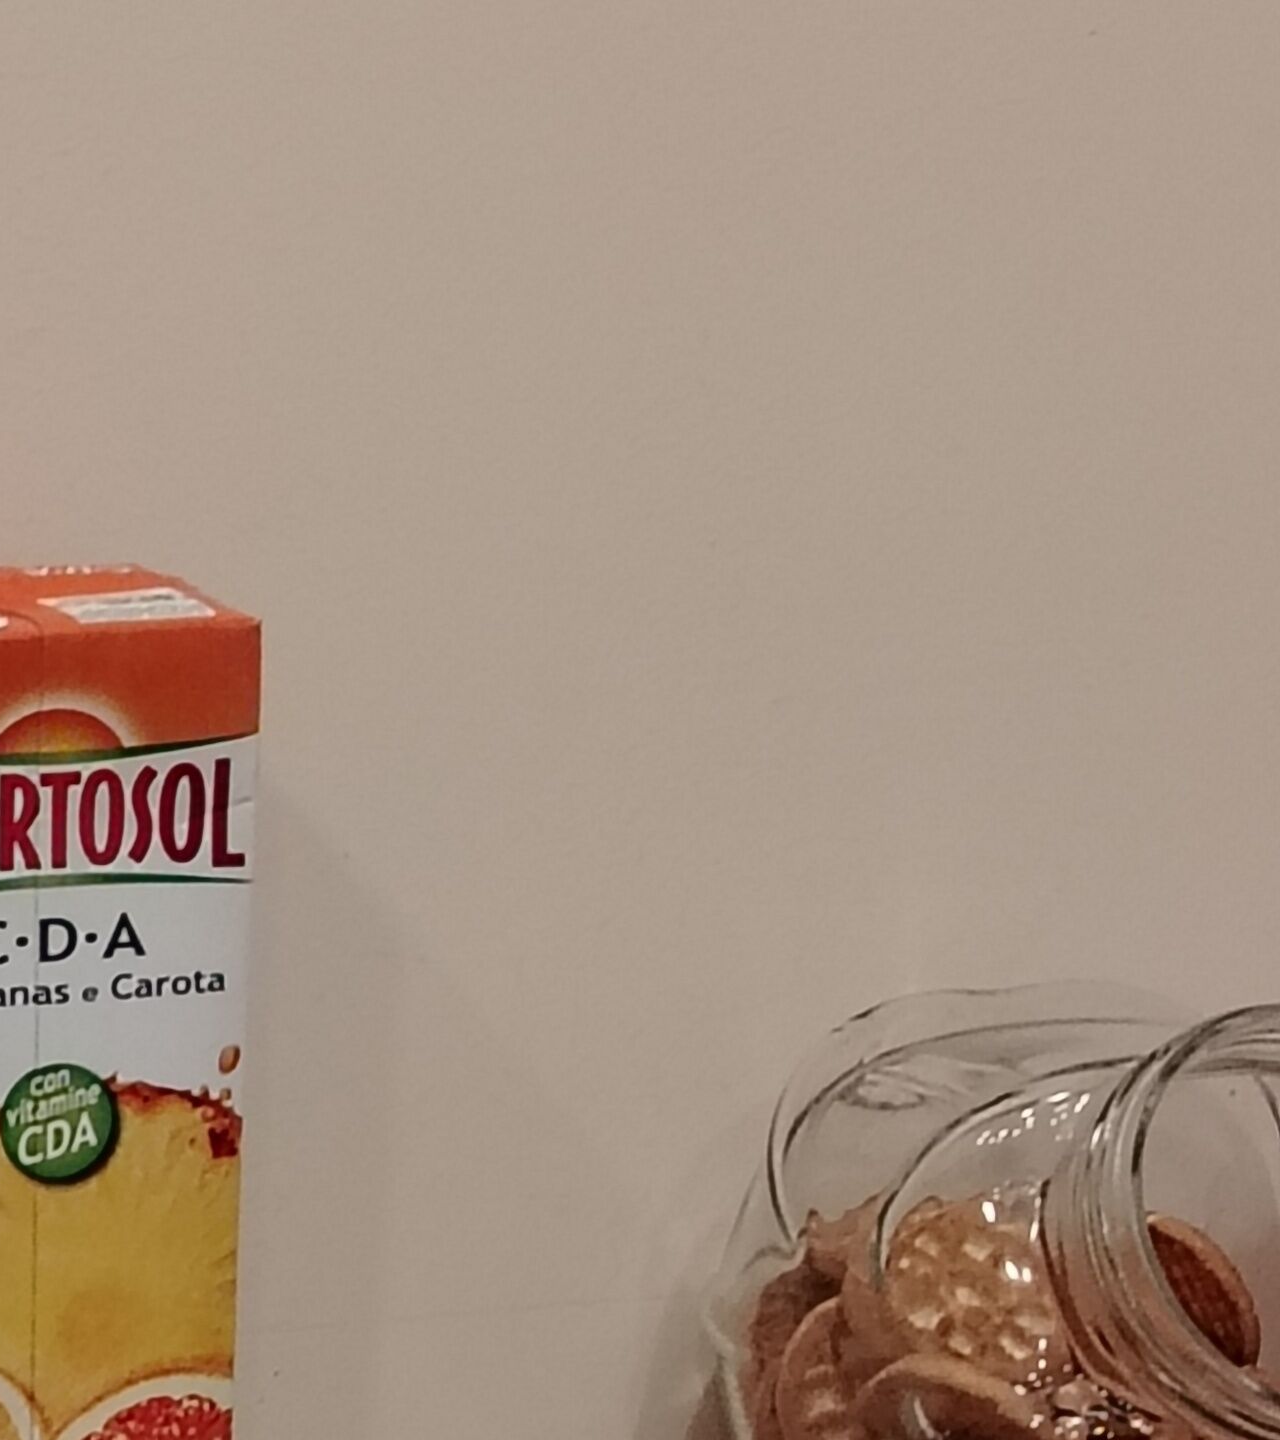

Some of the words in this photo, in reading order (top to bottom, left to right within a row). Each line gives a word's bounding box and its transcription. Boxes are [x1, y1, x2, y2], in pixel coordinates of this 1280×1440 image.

[81, 986, 99, 1003] e
[111, 970, 226, 1001] Carota
[29, 1069, 71, 1097] con
[6, 1083, 102, 1128] vitamine
[17, 1111, 99, 1166] CDA
